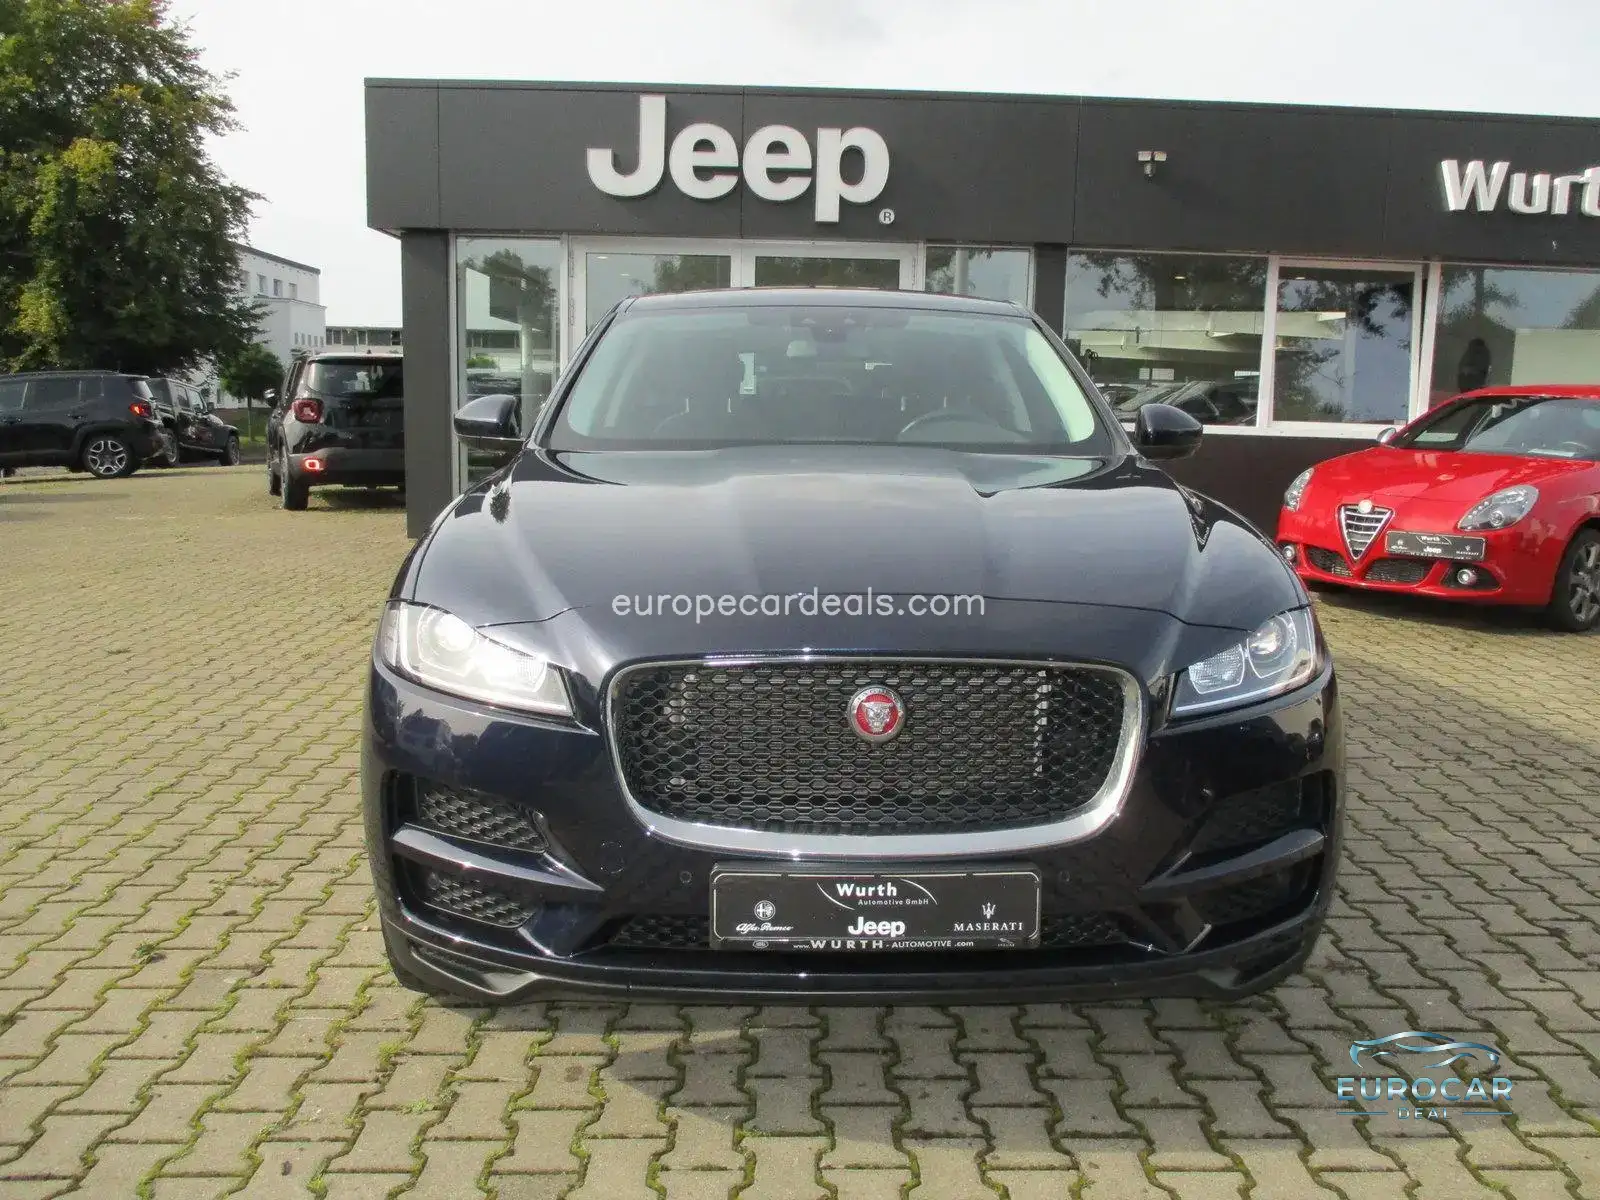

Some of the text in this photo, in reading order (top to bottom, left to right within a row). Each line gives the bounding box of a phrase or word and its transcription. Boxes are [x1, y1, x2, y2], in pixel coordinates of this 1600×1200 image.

[587, 95, 890, 222] Jeep
[836, 882, 897, 897] Wurth
[858, 898, 903, 906] Automotive
[848, 917, 906, 938] Jeep
[954, 922, 1023, 932] MASERATI
